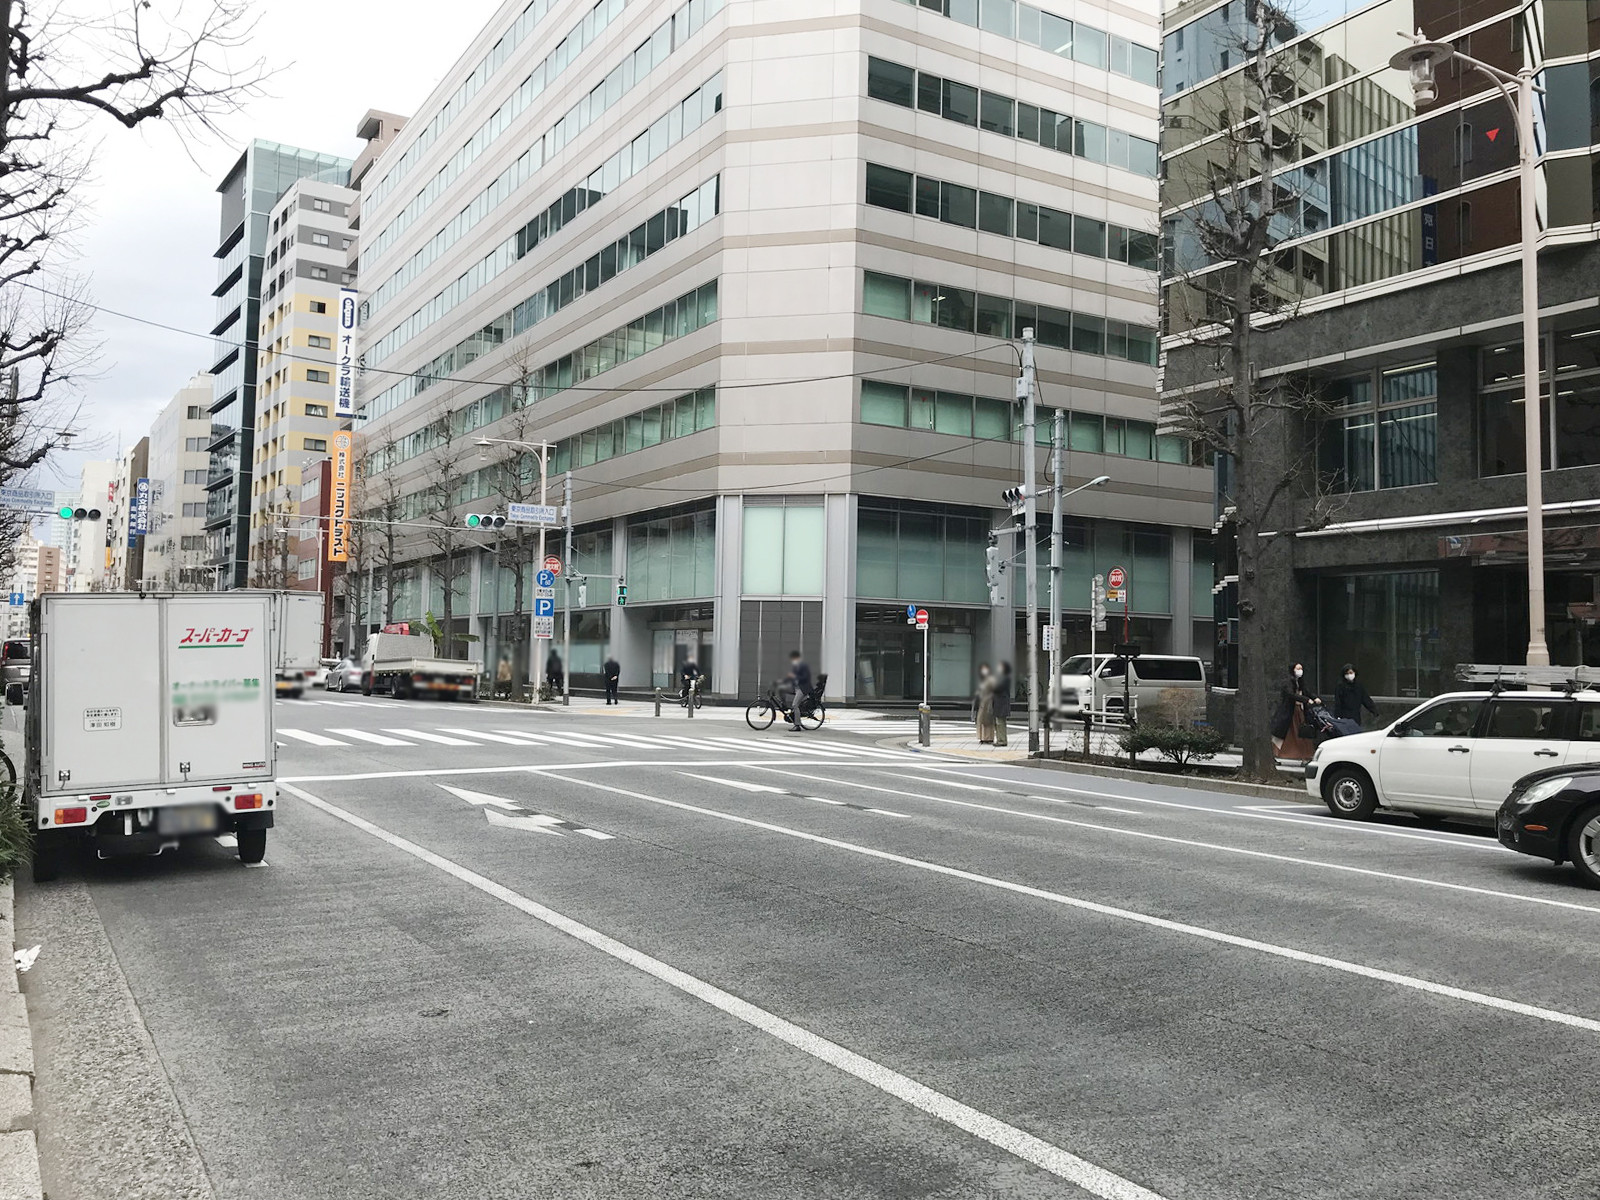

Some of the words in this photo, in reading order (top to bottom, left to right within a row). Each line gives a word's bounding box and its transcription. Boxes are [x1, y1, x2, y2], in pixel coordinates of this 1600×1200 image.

[339, 335, 352, 409] オークラ輸送機
[337, 452, 346, 478] 株式会社
[333, 482, 345, 556] ニッコクトラスト
[540, 573, 548, 585] P
[540, 600, 551, 615] P
[180, 627, 254, 643] スーパーカーゴ
